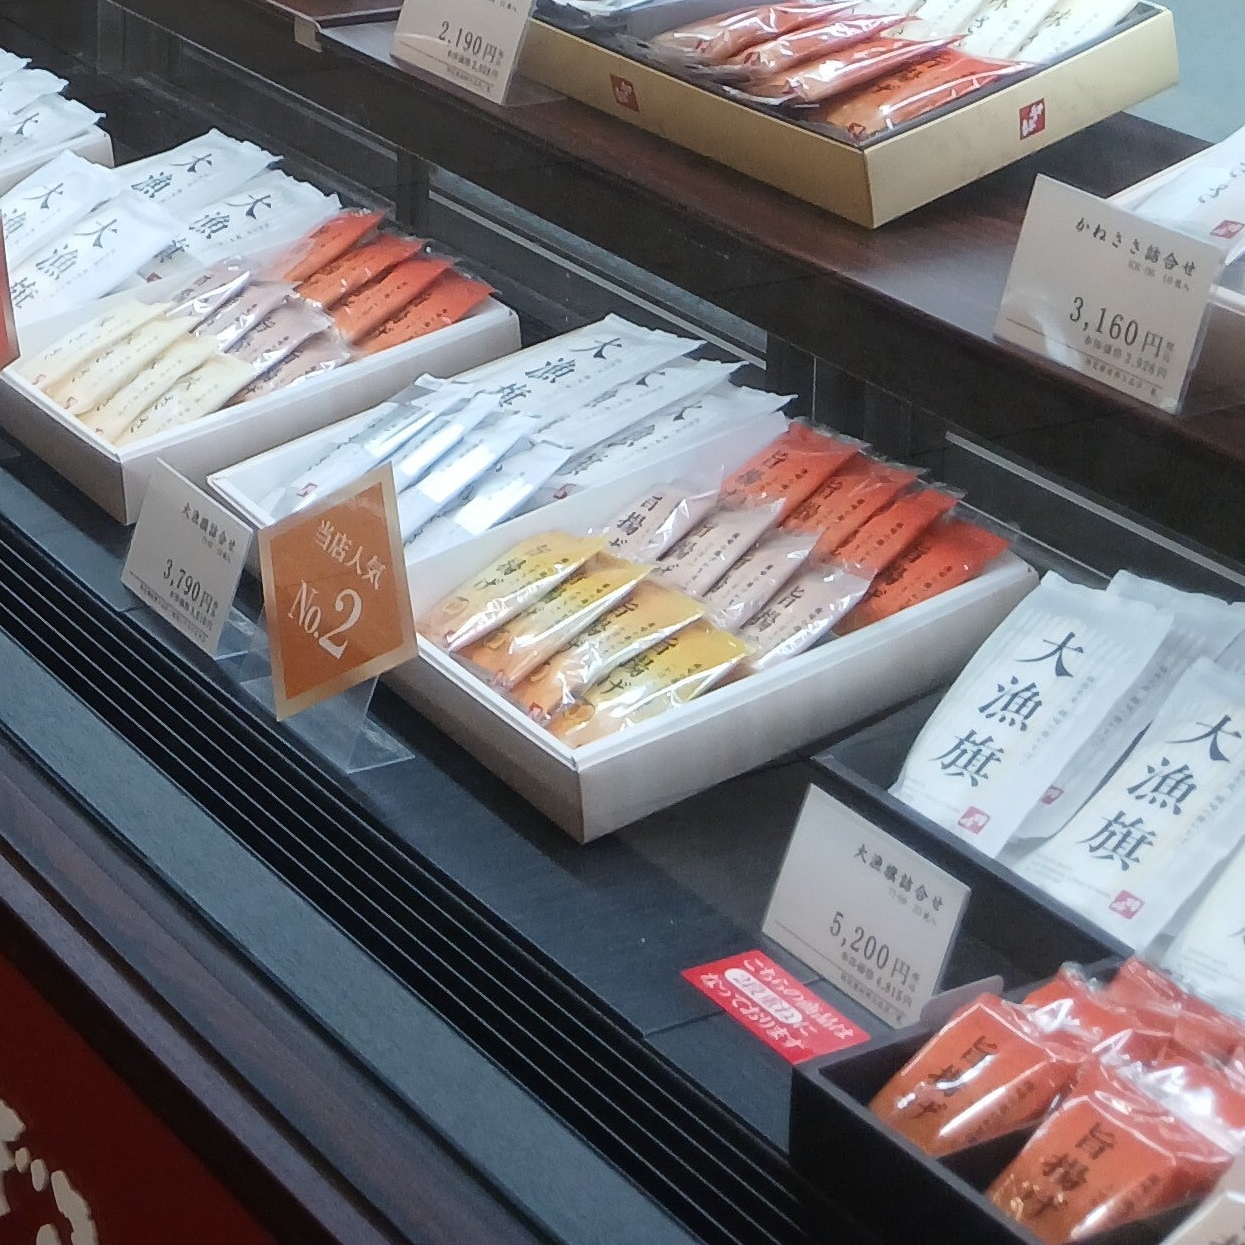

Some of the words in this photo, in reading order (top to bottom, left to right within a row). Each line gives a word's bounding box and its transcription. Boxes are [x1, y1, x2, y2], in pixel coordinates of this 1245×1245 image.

[1068, 296, 1164, 360] 3,160円
[162, 558, 214, 615] 3,790円
[312, 519, 388, 590] 当店人気
[287, 579, 362, 660] No.2
[928, 631, 1085, 789] 大漁旗
[1075, 713, 1243, 872] 大漁旗
[828, 910, 911, 986] 5,200円
